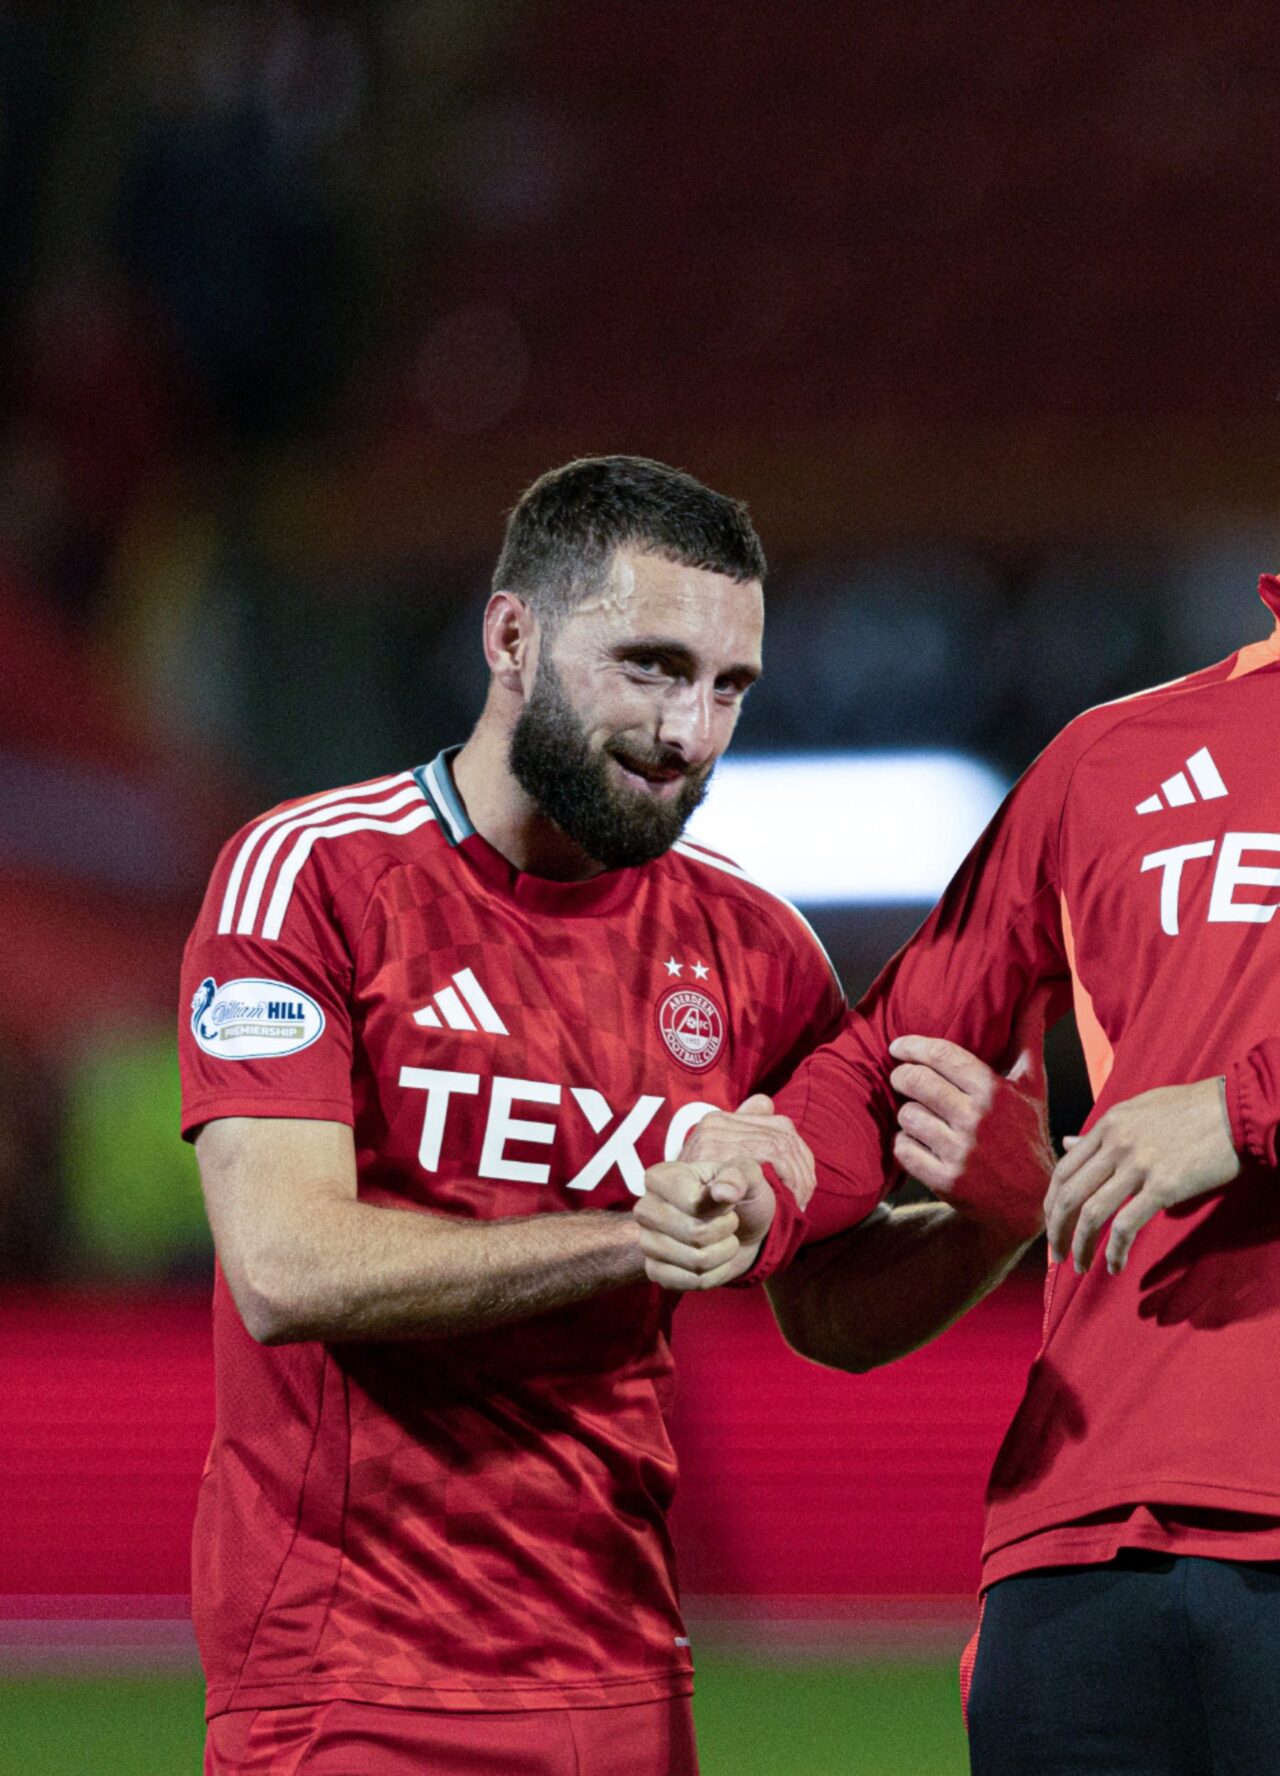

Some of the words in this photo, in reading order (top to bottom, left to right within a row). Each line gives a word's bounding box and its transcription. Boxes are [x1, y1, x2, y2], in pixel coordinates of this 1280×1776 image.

[267, 1001, 306, 1020] HILL
[668, 993, 716, 1017] ABERDEEN
[224, 1025, 298, 1039] PREMIERSHIP
[663, 1027, 703, 1064] FOOTBALL
